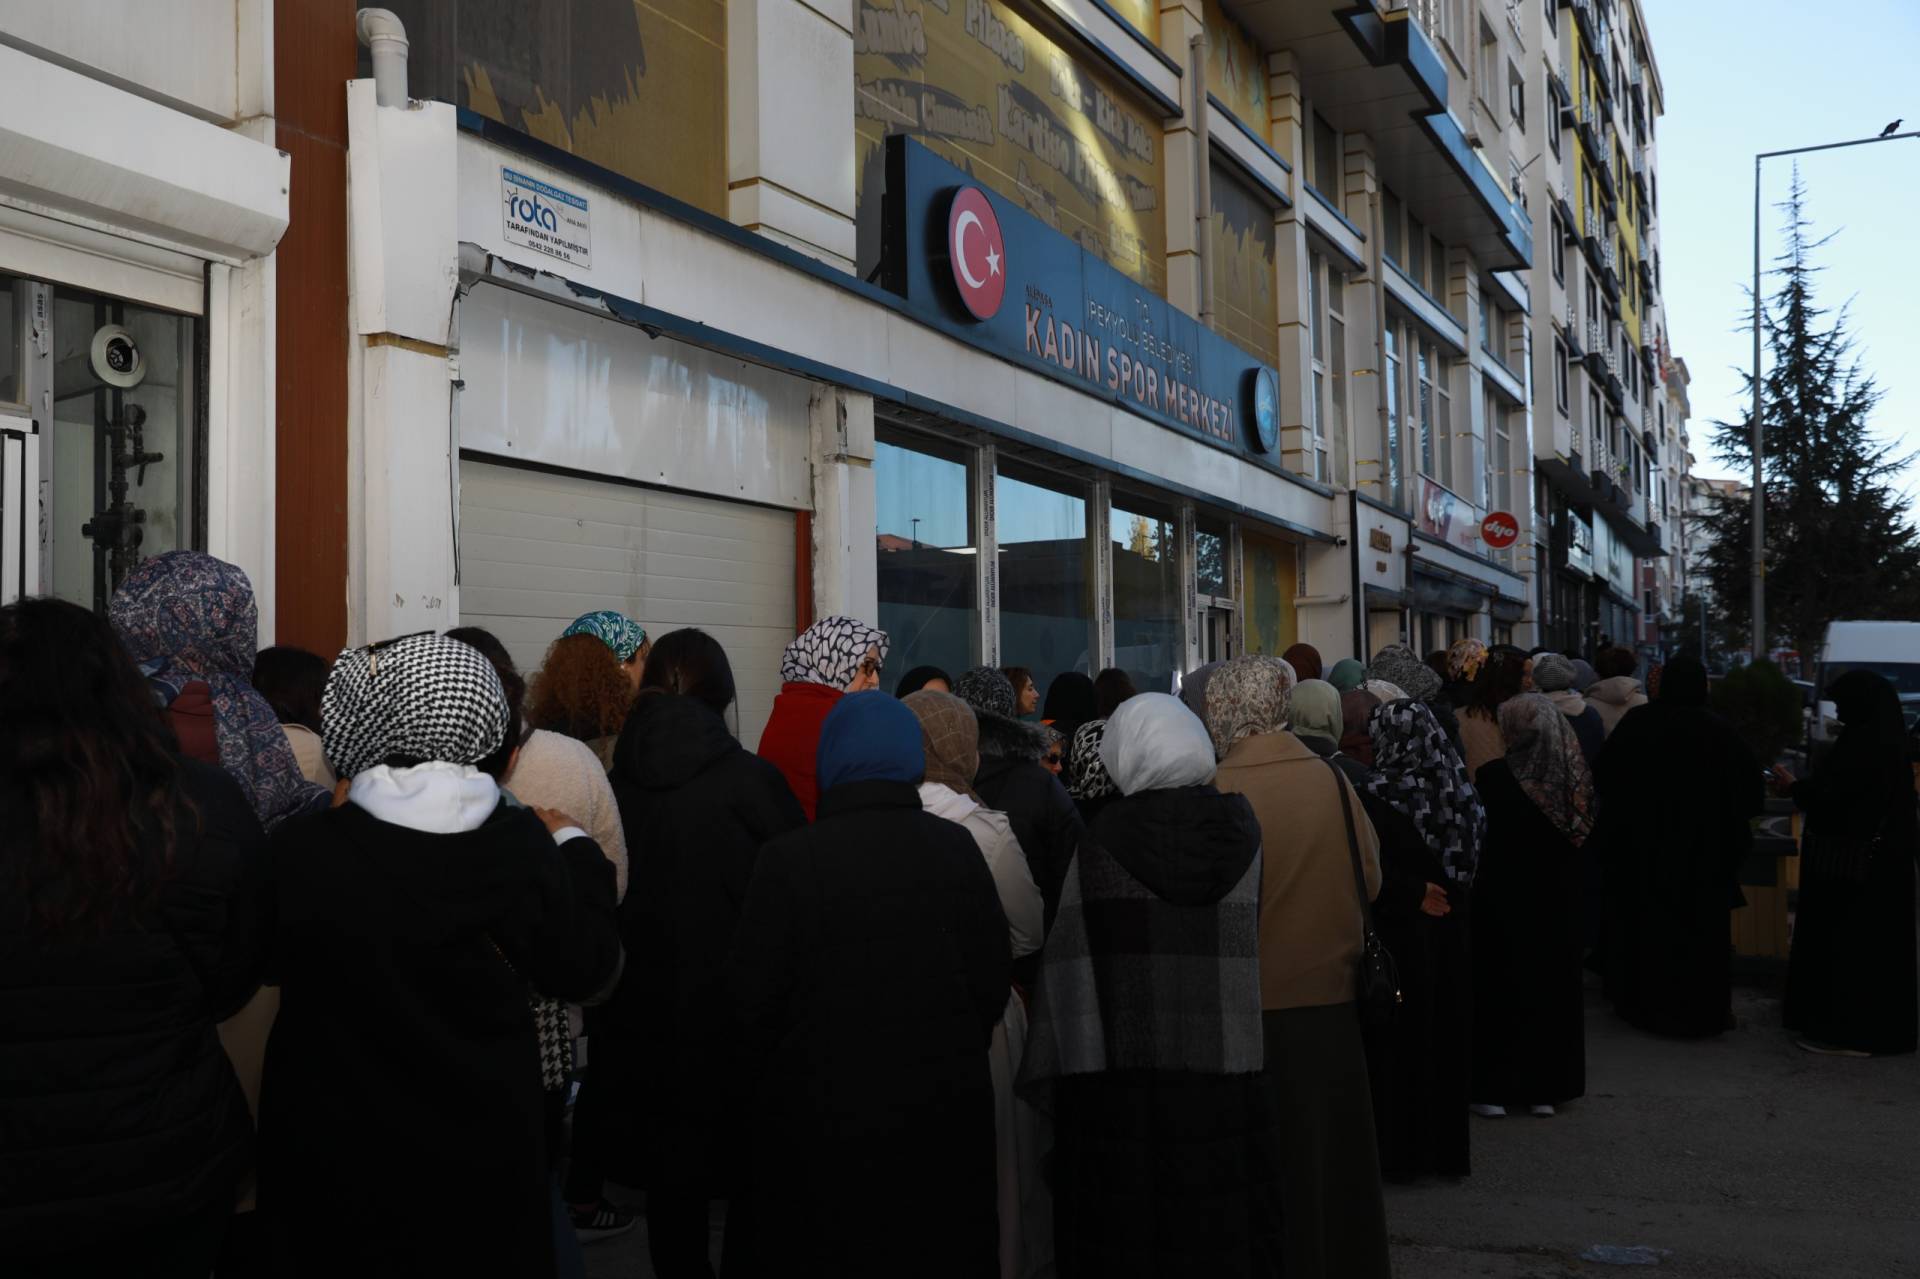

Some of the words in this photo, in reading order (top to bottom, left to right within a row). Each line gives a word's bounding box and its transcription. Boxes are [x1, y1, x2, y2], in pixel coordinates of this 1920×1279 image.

[511, 194, 557, 233] rota
[507, 220, 549, 240] TARAFINDAN
[1025, 302, 1100, 384] KADIN
[1107, 346, 1159, 409] SPOR
[1164, 374, 1235, 442] MERKEZİ
[1484, 521, 1515, 538] dyo
